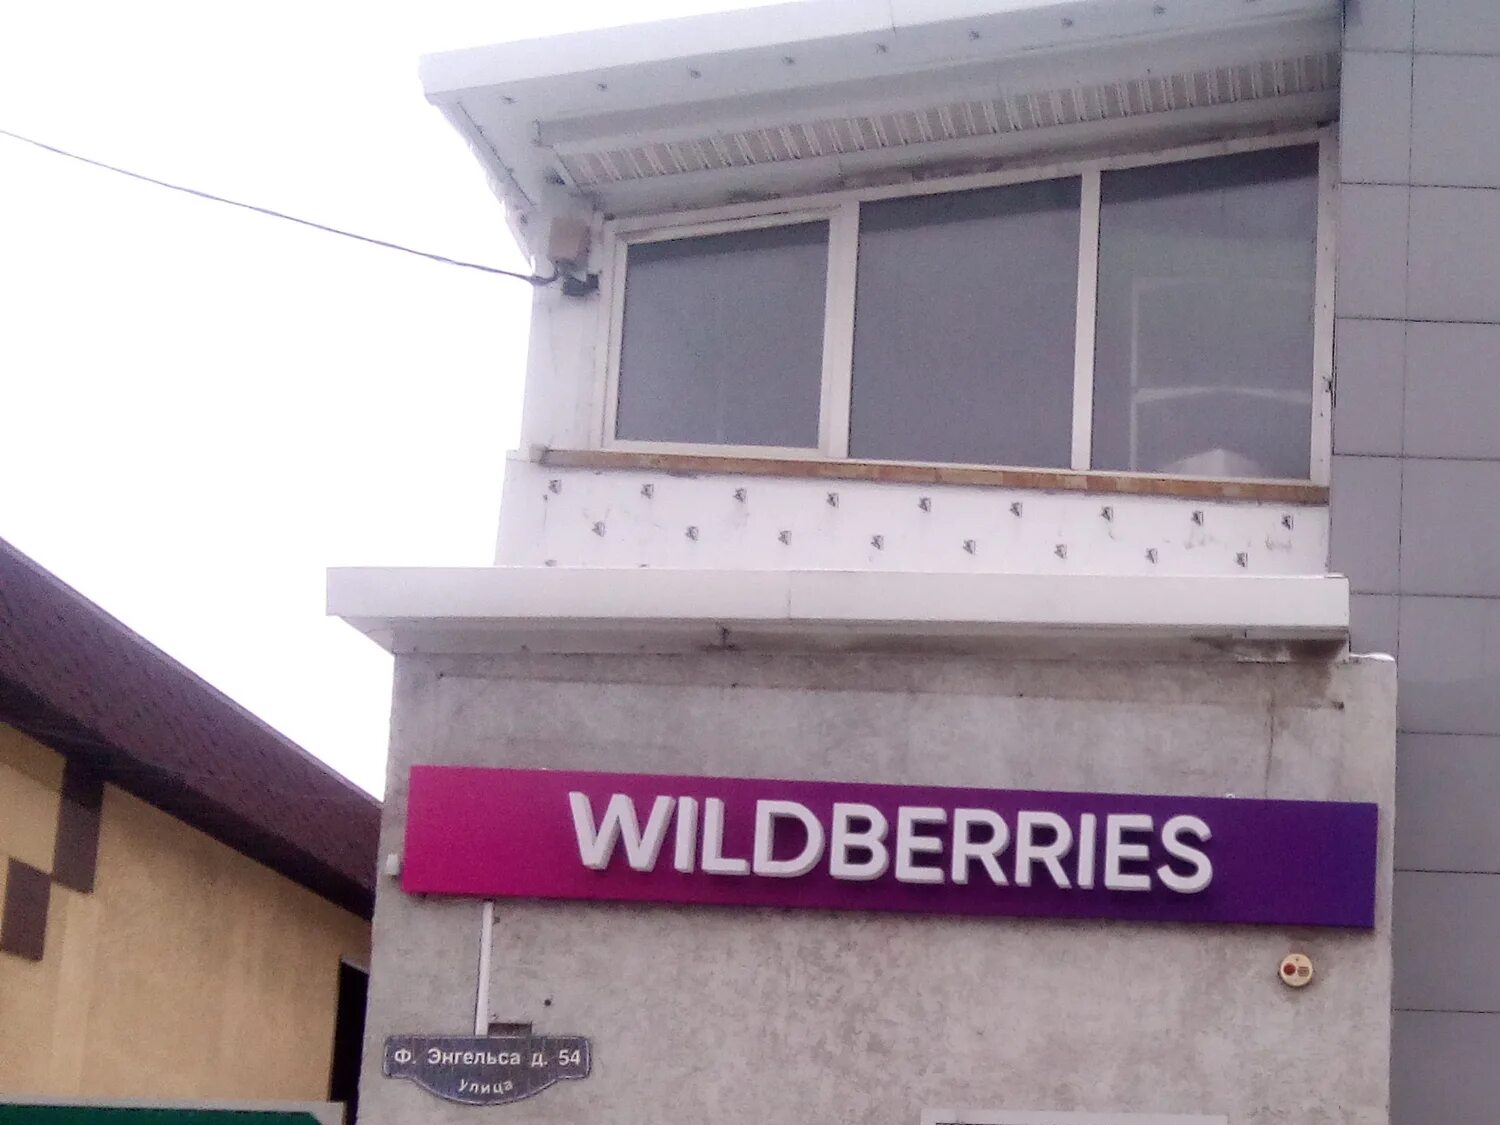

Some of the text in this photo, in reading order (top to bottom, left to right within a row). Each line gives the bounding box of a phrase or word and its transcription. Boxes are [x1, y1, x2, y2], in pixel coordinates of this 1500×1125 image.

[568, 790, 1214, 895] WILDBERRIES
[427, 1048, 521, 1066] Энгельса
[558, 1049, 581, 1066] 54
